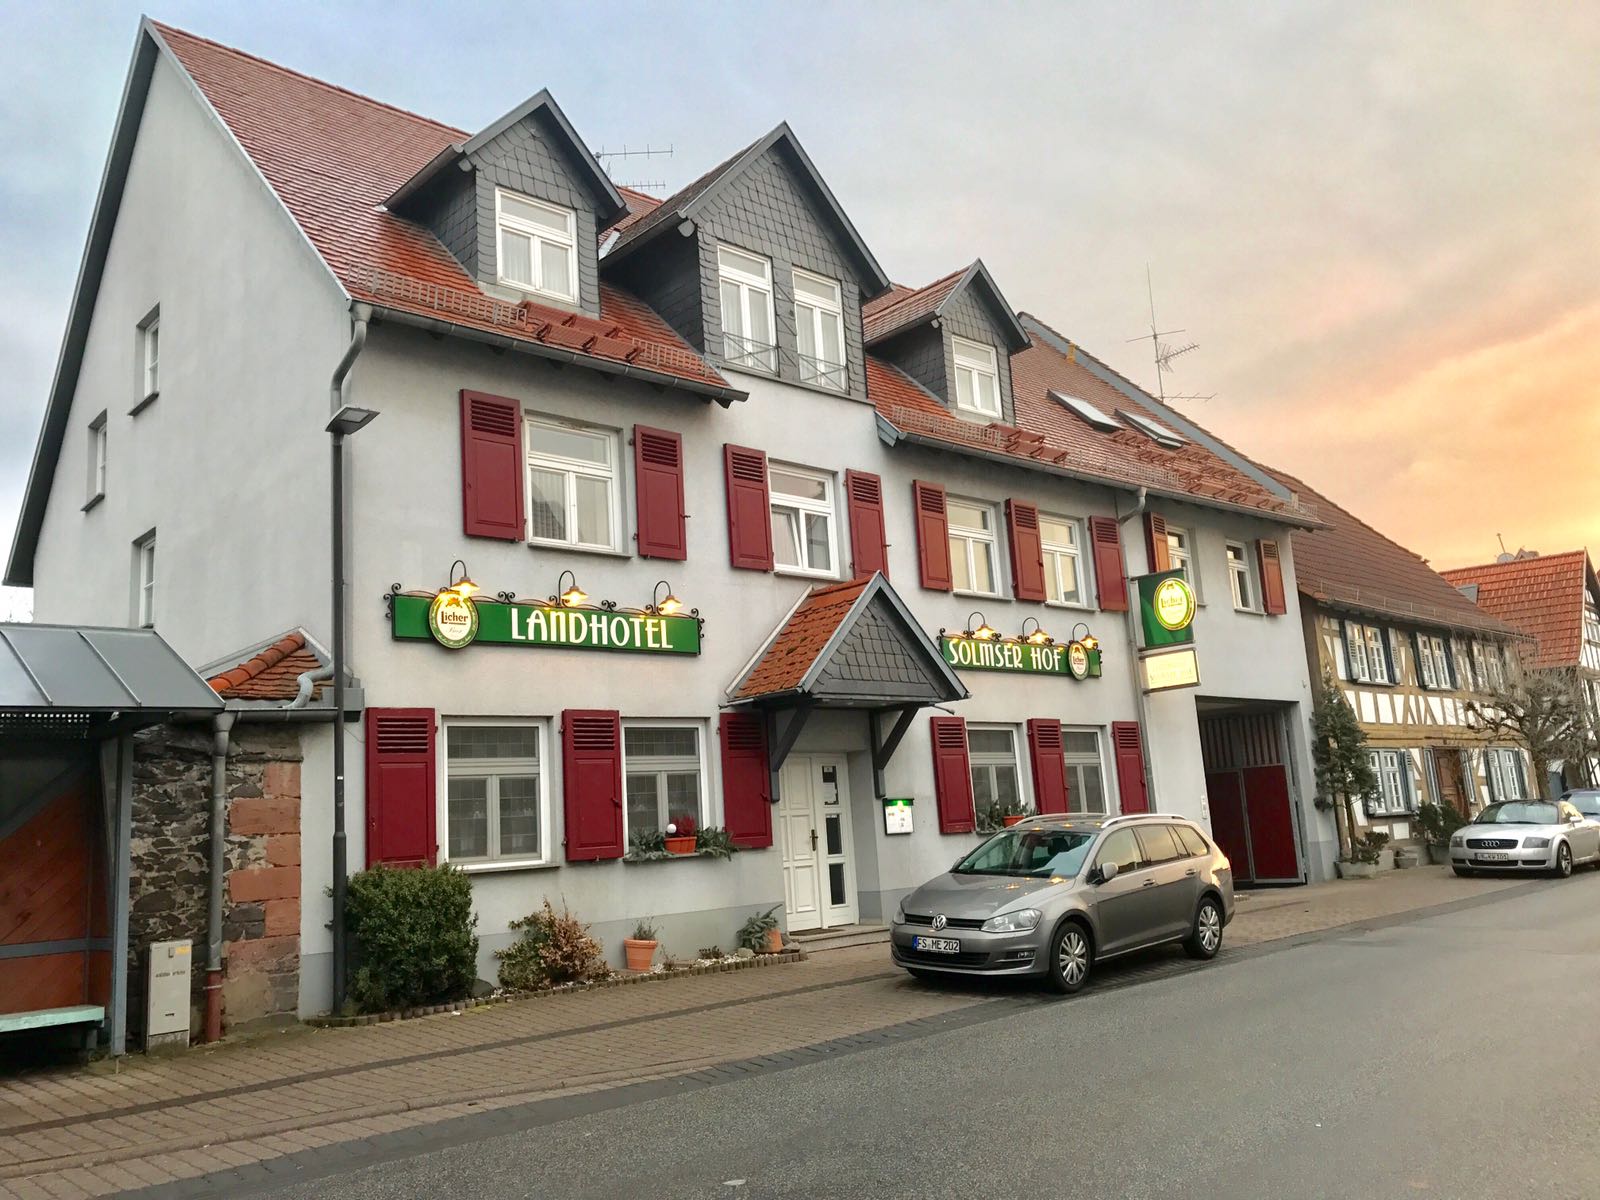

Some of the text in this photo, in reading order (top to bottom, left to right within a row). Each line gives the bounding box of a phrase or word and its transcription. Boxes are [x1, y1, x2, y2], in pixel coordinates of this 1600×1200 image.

[441, 611, 469, 625] Licher
[511, 607, 674, 649] LANDHOTEL
[949, 639, 1061, 671] SOLMSER HOF
[917, 938, 959, 951] FS ME 202
